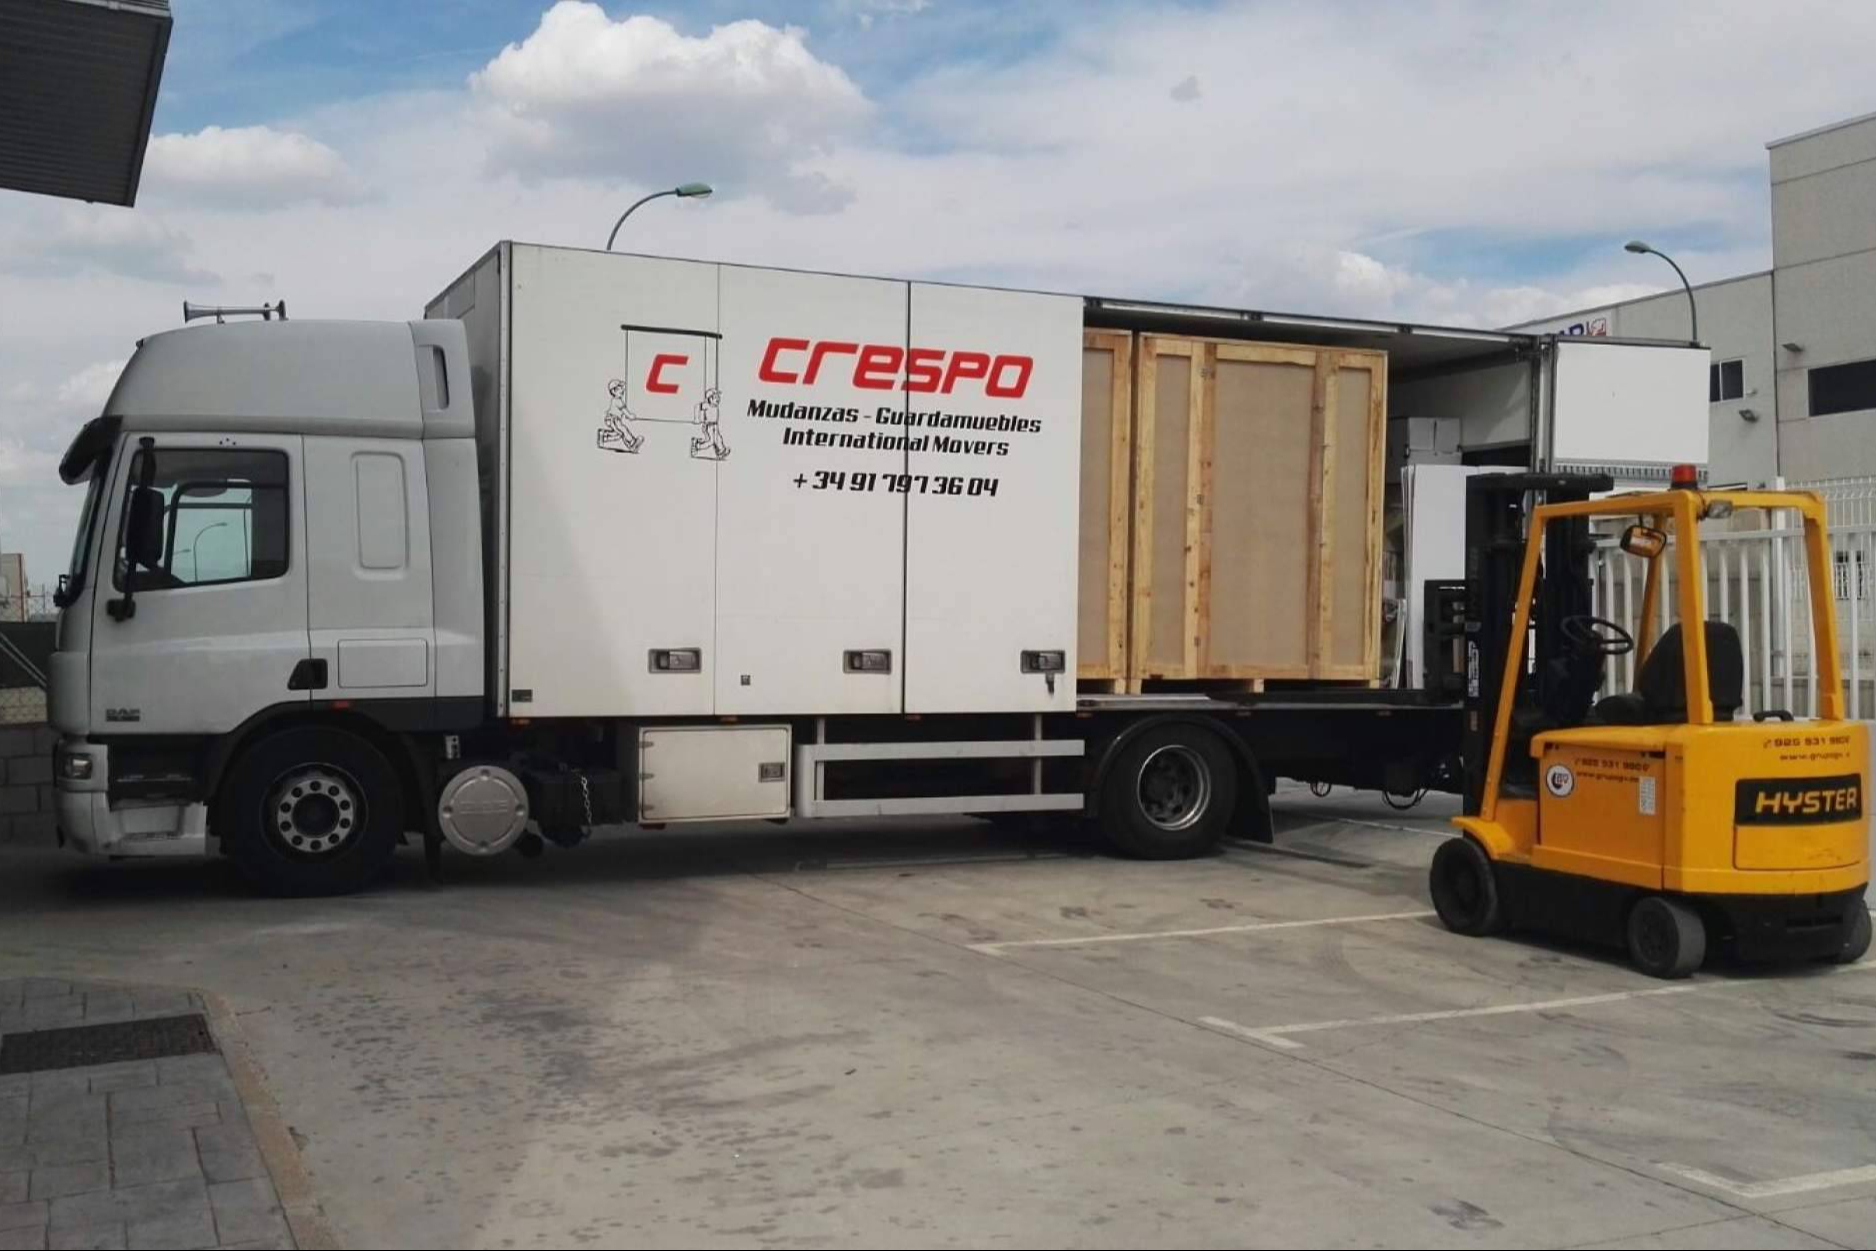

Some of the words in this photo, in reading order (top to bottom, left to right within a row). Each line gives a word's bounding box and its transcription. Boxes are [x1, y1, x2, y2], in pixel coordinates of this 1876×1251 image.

[645, 354, 689, 394] C
[747, 399, 859, 423] Mudanzas
[875, 407, 1042, 433] Guardamuebles
[783, 427, 930, 452] International
[933, 436, 1010, 456] Movers
[812, 470, 846, 491] 34
[1755, 787, 1857, 814] HYSTER
